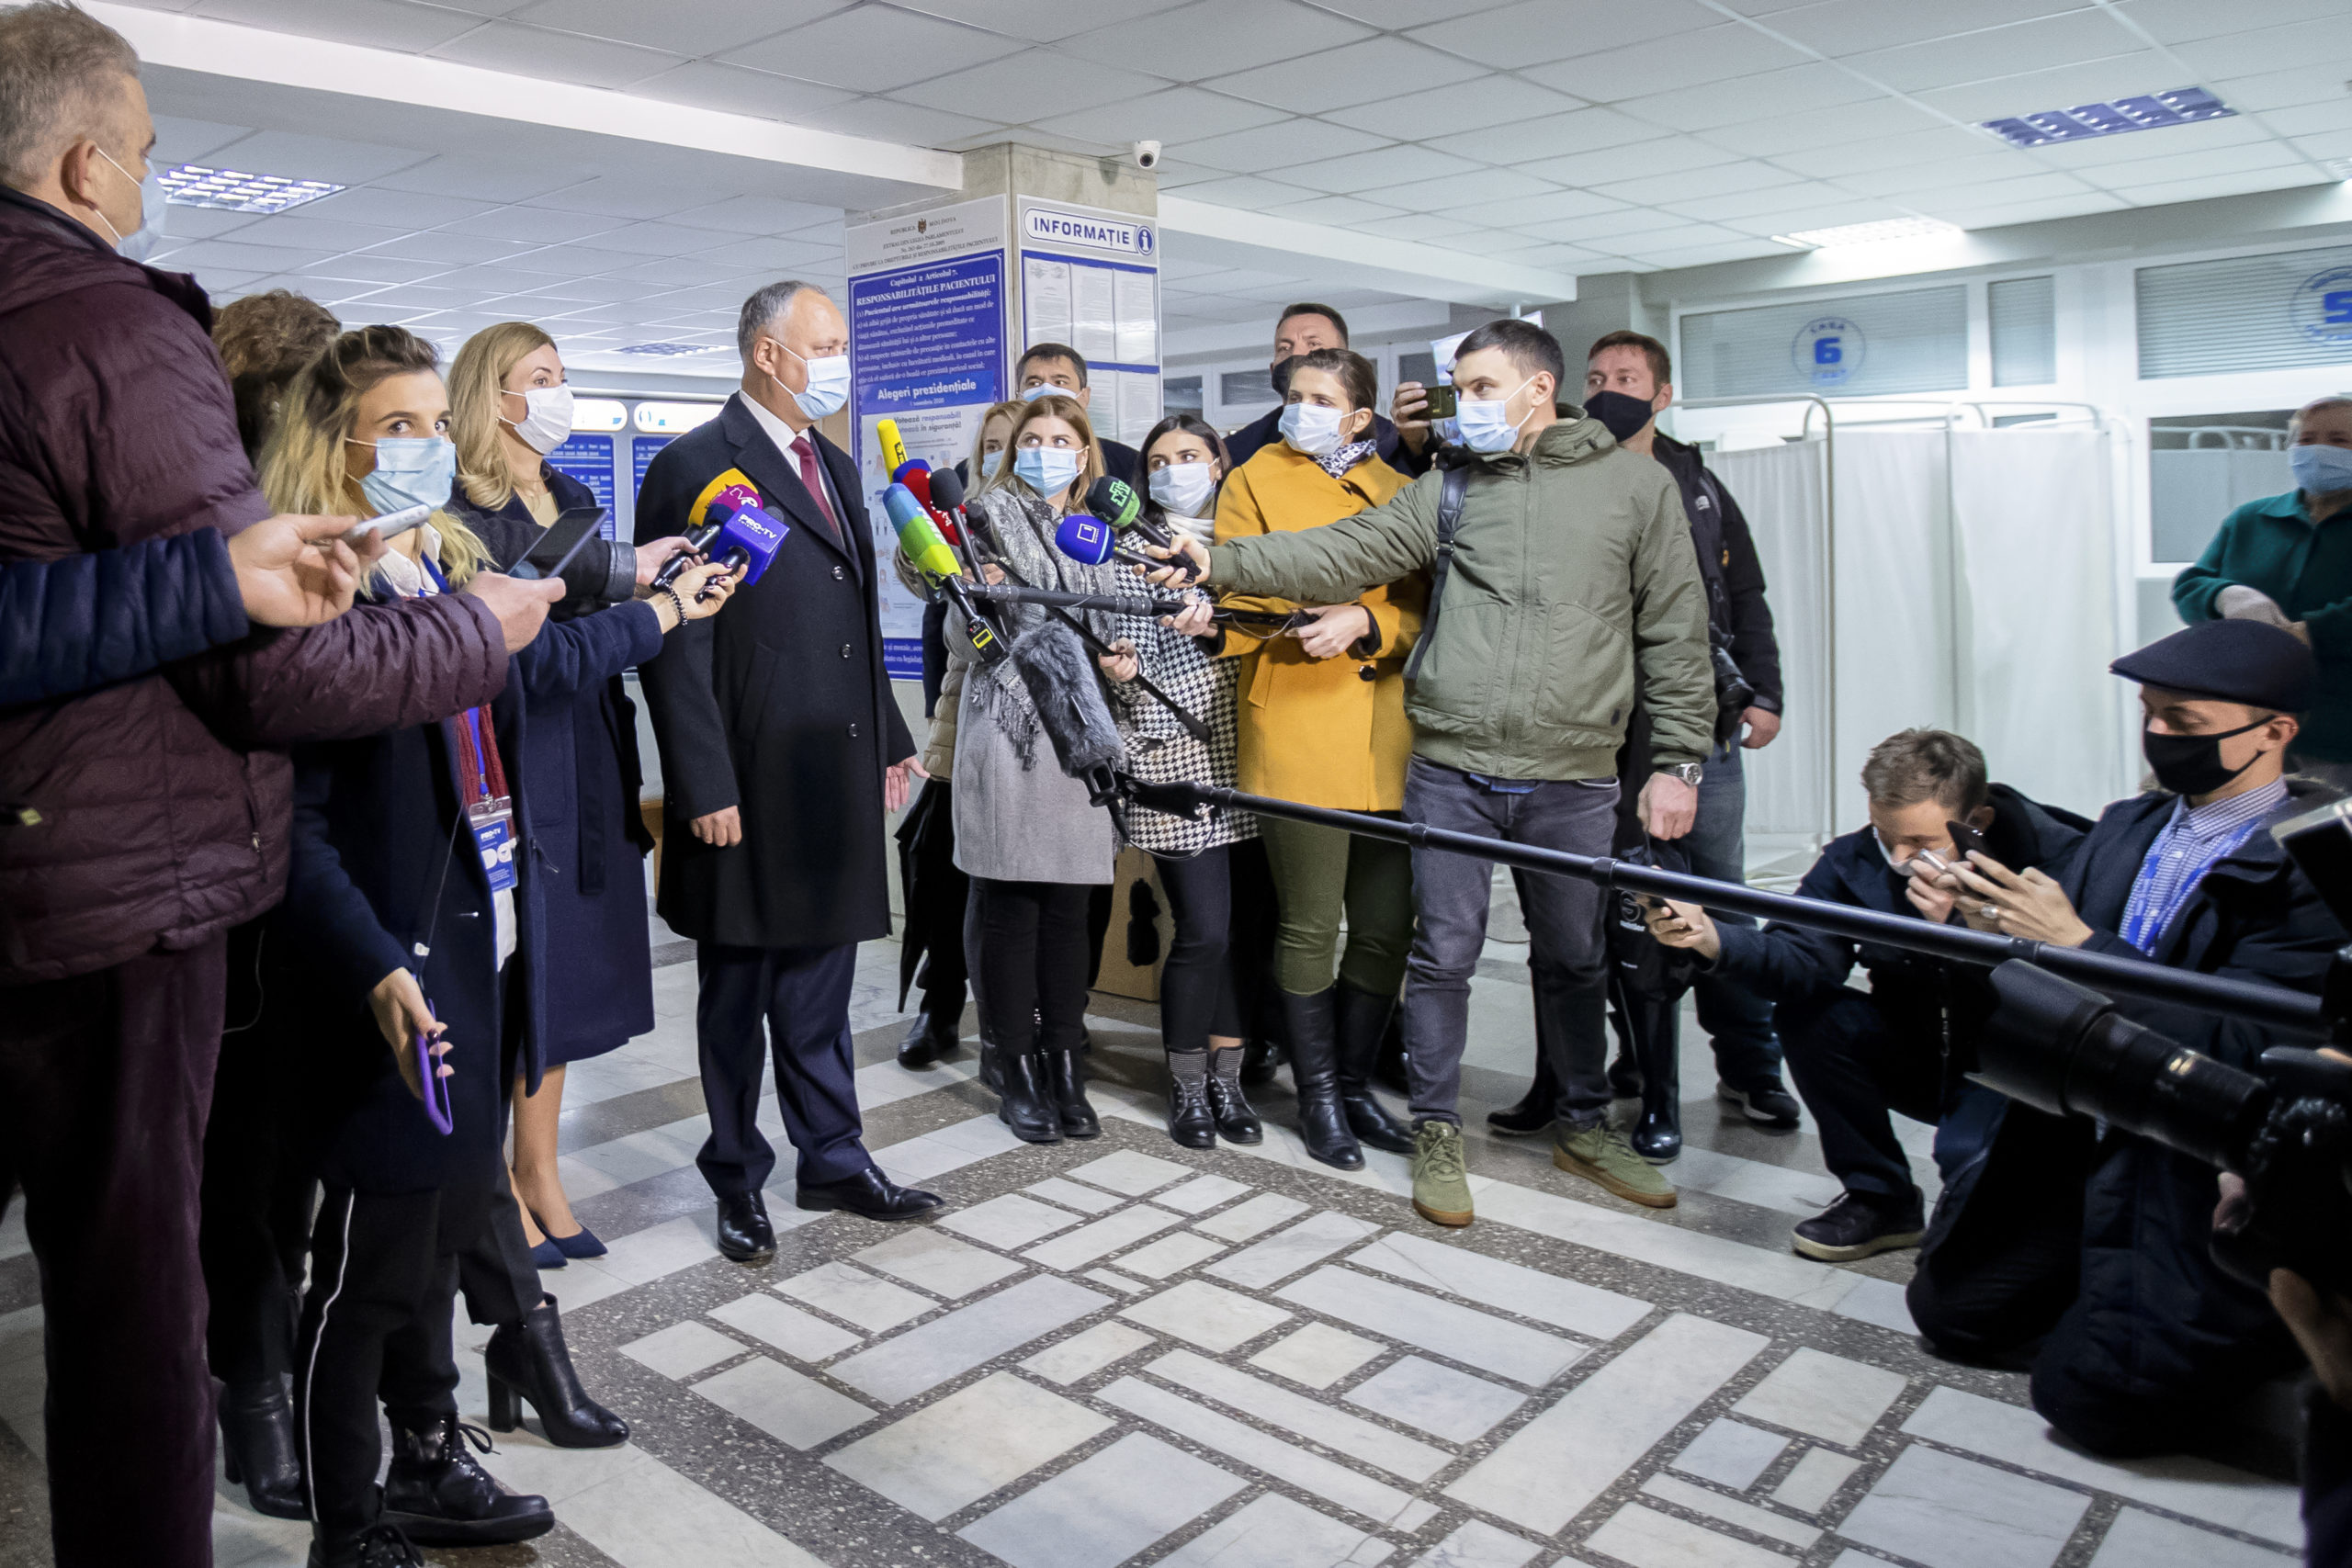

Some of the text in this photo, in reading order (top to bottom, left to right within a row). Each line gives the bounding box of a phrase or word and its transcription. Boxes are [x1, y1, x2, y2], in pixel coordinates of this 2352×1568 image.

[1034, 217, 1130, 247] INFORMAȚIE
[889, 275, 917, 288] Capitolul
[924, 268, 952, 281] Articolul
[940, 274, 996, 291] PACIENTULUI
[864, 305, 891, 317] Pacientul
[1815, 336, 1843, 366] 6
[877, 378, 978, 402] Alegeri prezidențiale
